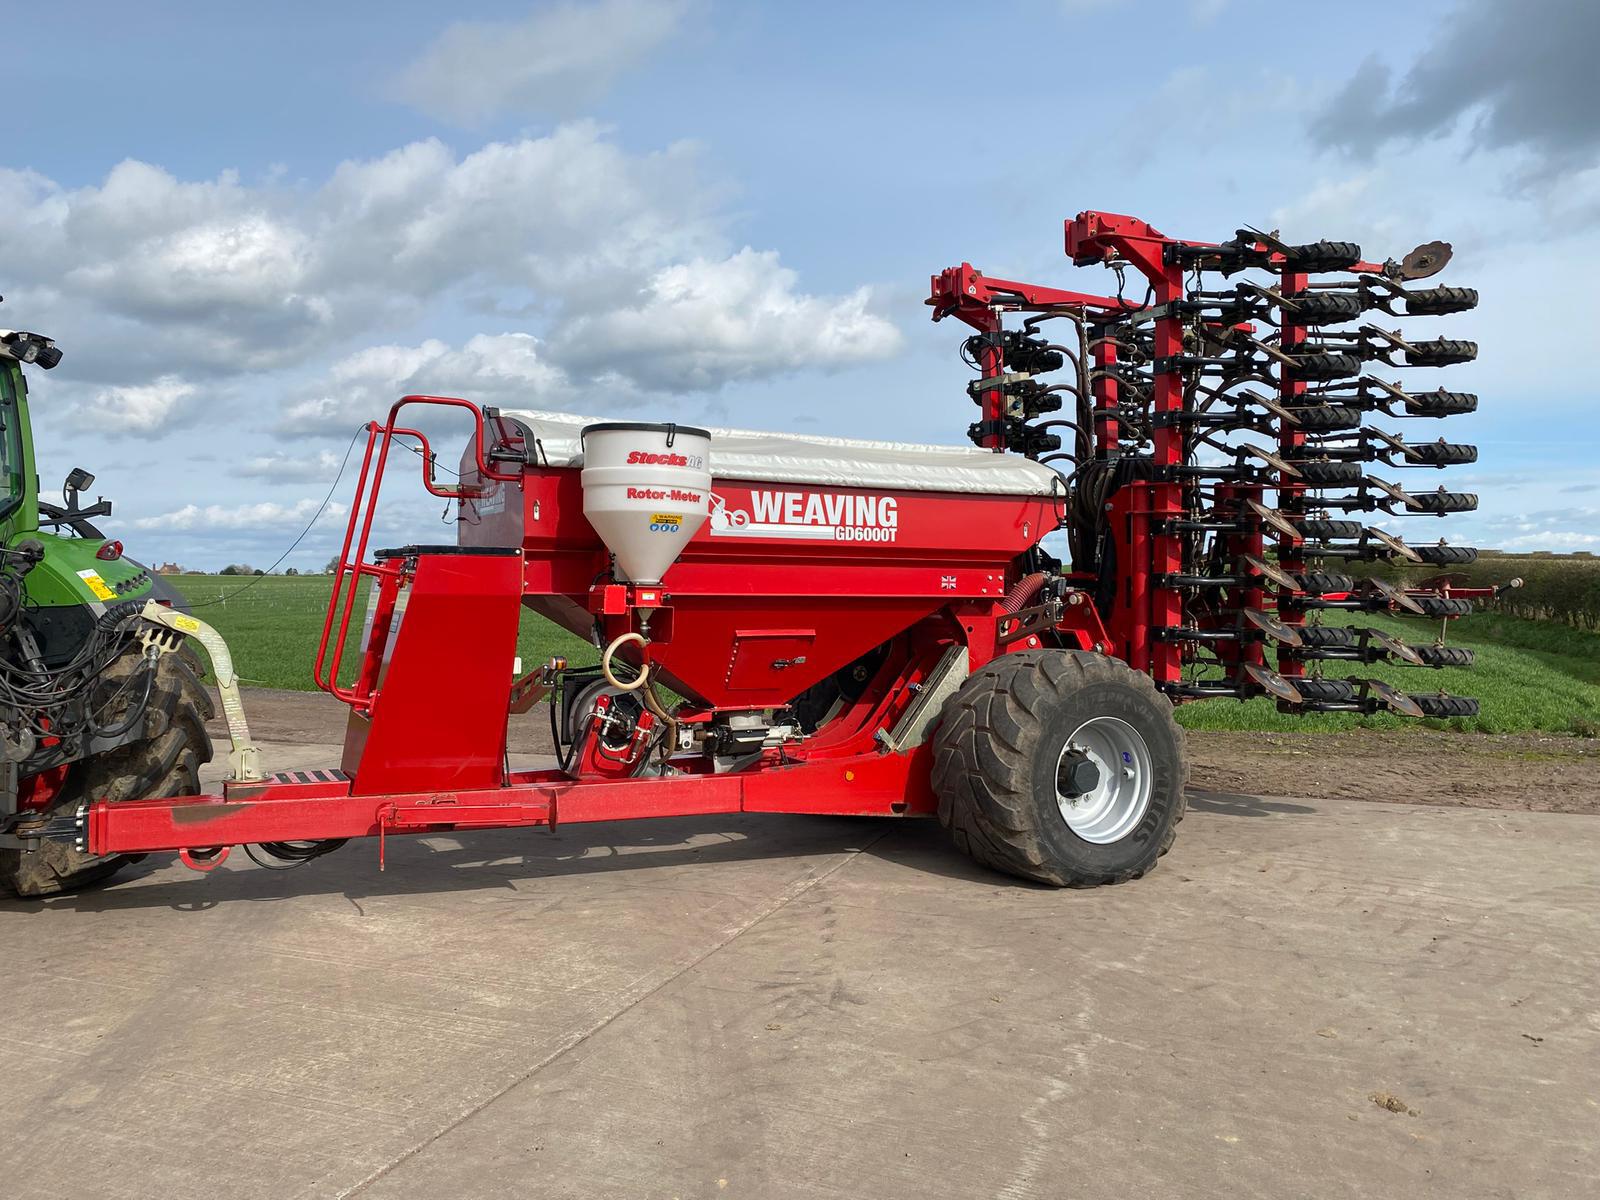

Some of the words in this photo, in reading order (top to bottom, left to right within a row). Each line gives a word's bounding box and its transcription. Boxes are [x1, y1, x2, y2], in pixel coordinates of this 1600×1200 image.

[627, 451, 687, 466] Stocks
[627, 487, 701, 503] Rotor-Meter
[751, 490, 898, 528] WEAVING
[835, 526, 897, 542] GD6000T
